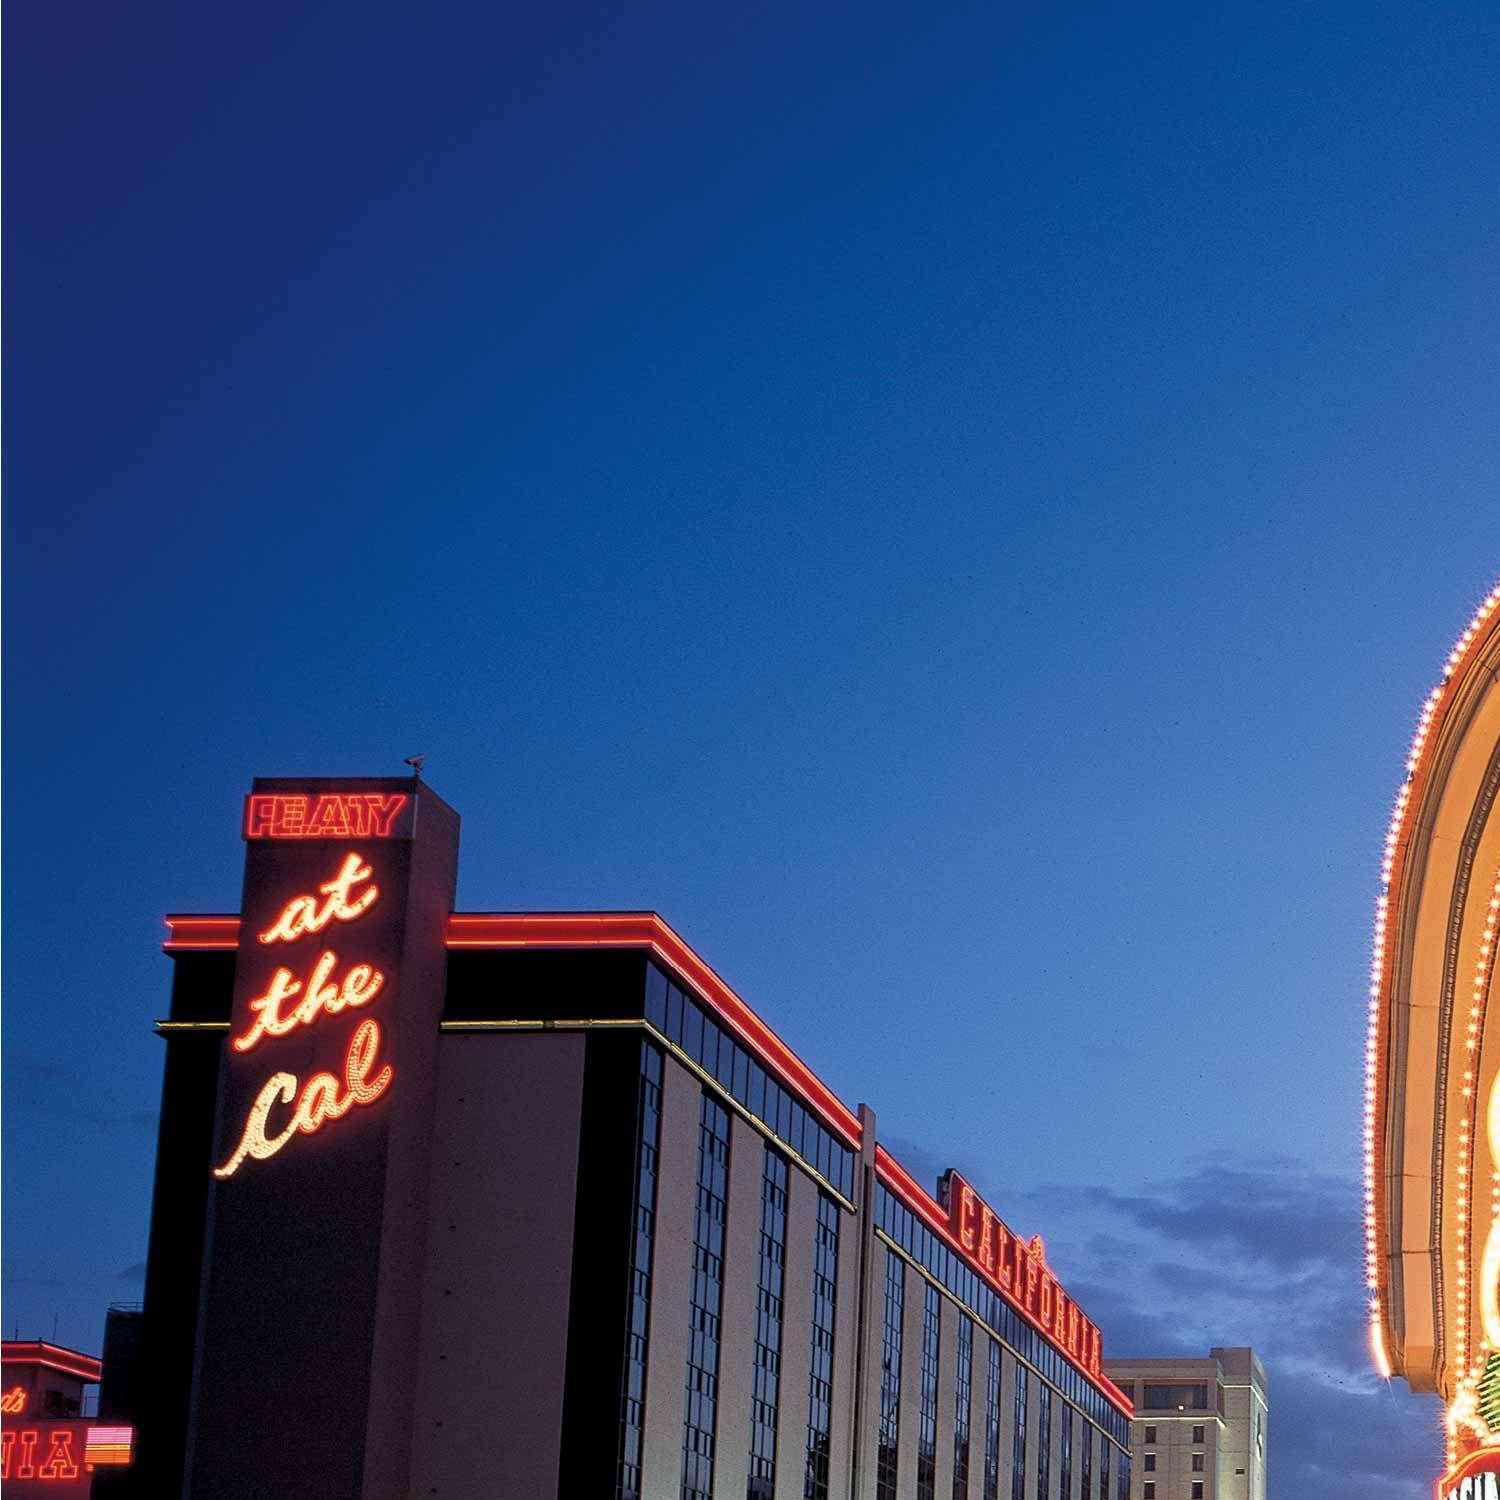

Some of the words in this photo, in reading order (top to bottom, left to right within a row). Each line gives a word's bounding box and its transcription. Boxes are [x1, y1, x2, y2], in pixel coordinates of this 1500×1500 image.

[259, 852, 379, 944] at
[233, 951, 385, 1051] the
[213, 1018, 393, 1180] Cal
[960, 1185, 1102, 1378] CALIFORNIA
